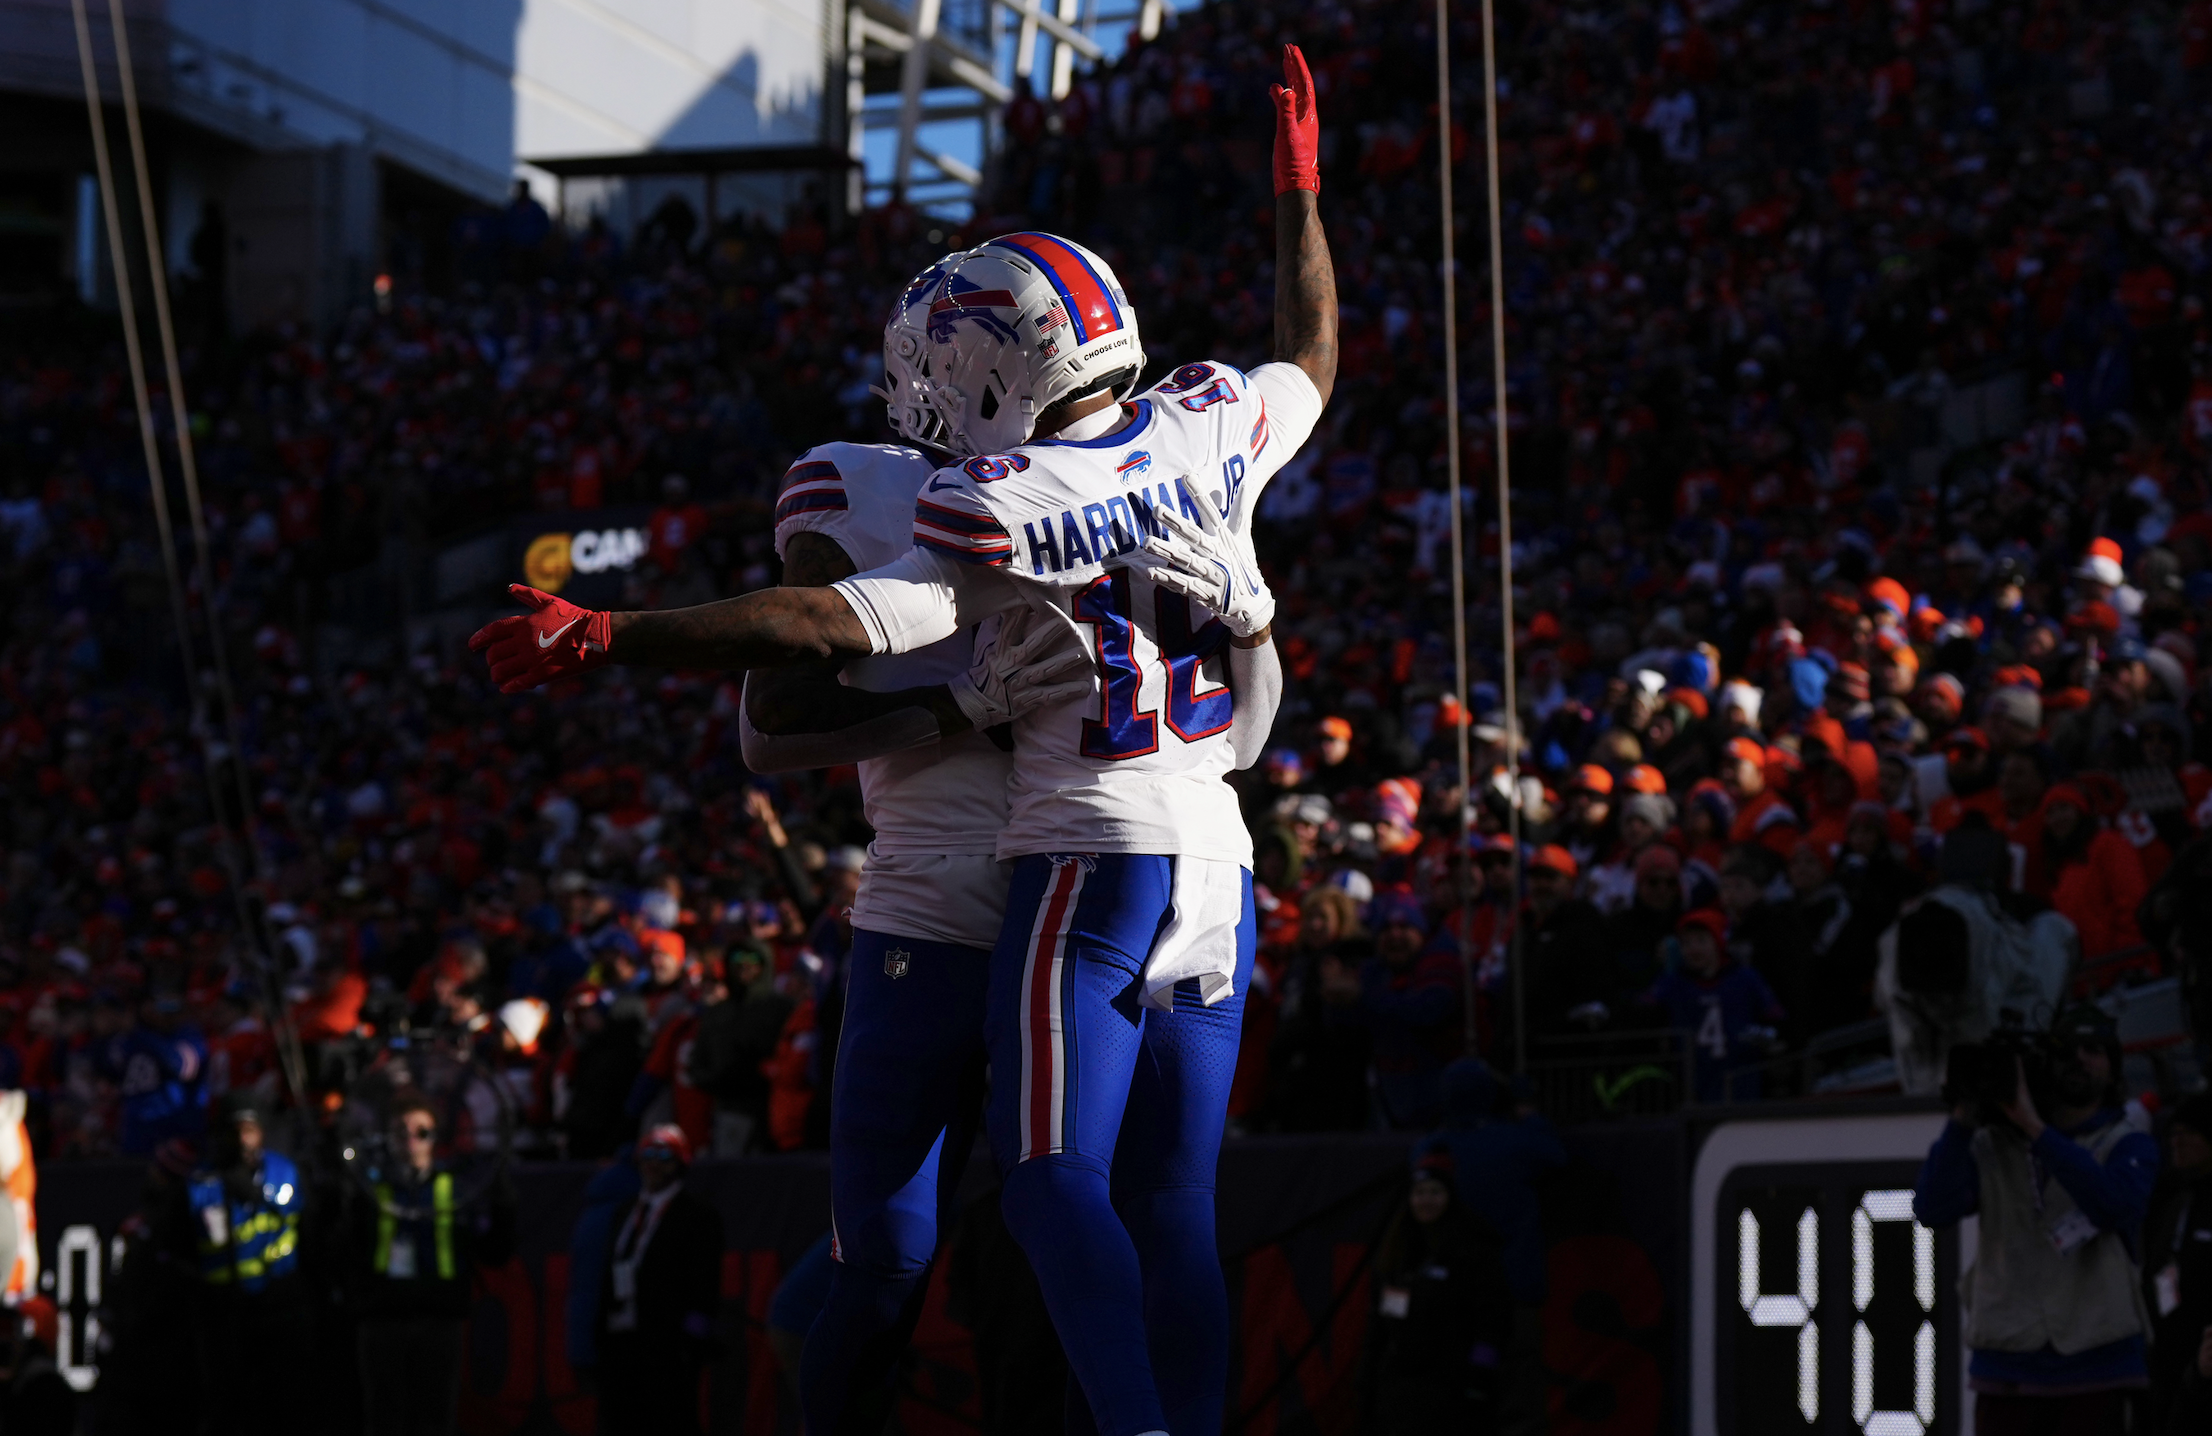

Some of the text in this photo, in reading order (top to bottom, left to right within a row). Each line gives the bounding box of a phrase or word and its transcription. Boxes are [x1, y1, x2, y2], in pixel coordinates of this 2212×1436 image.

[1043, 345, 1059, 358] NFL
[1083, 338, 1128, 361] CHOOSE LOVE
[888, 961, 906, 974] NFL
[1697, 995, 1727, 1060] 4
[1737, 1187, 1937, 1436] 40
